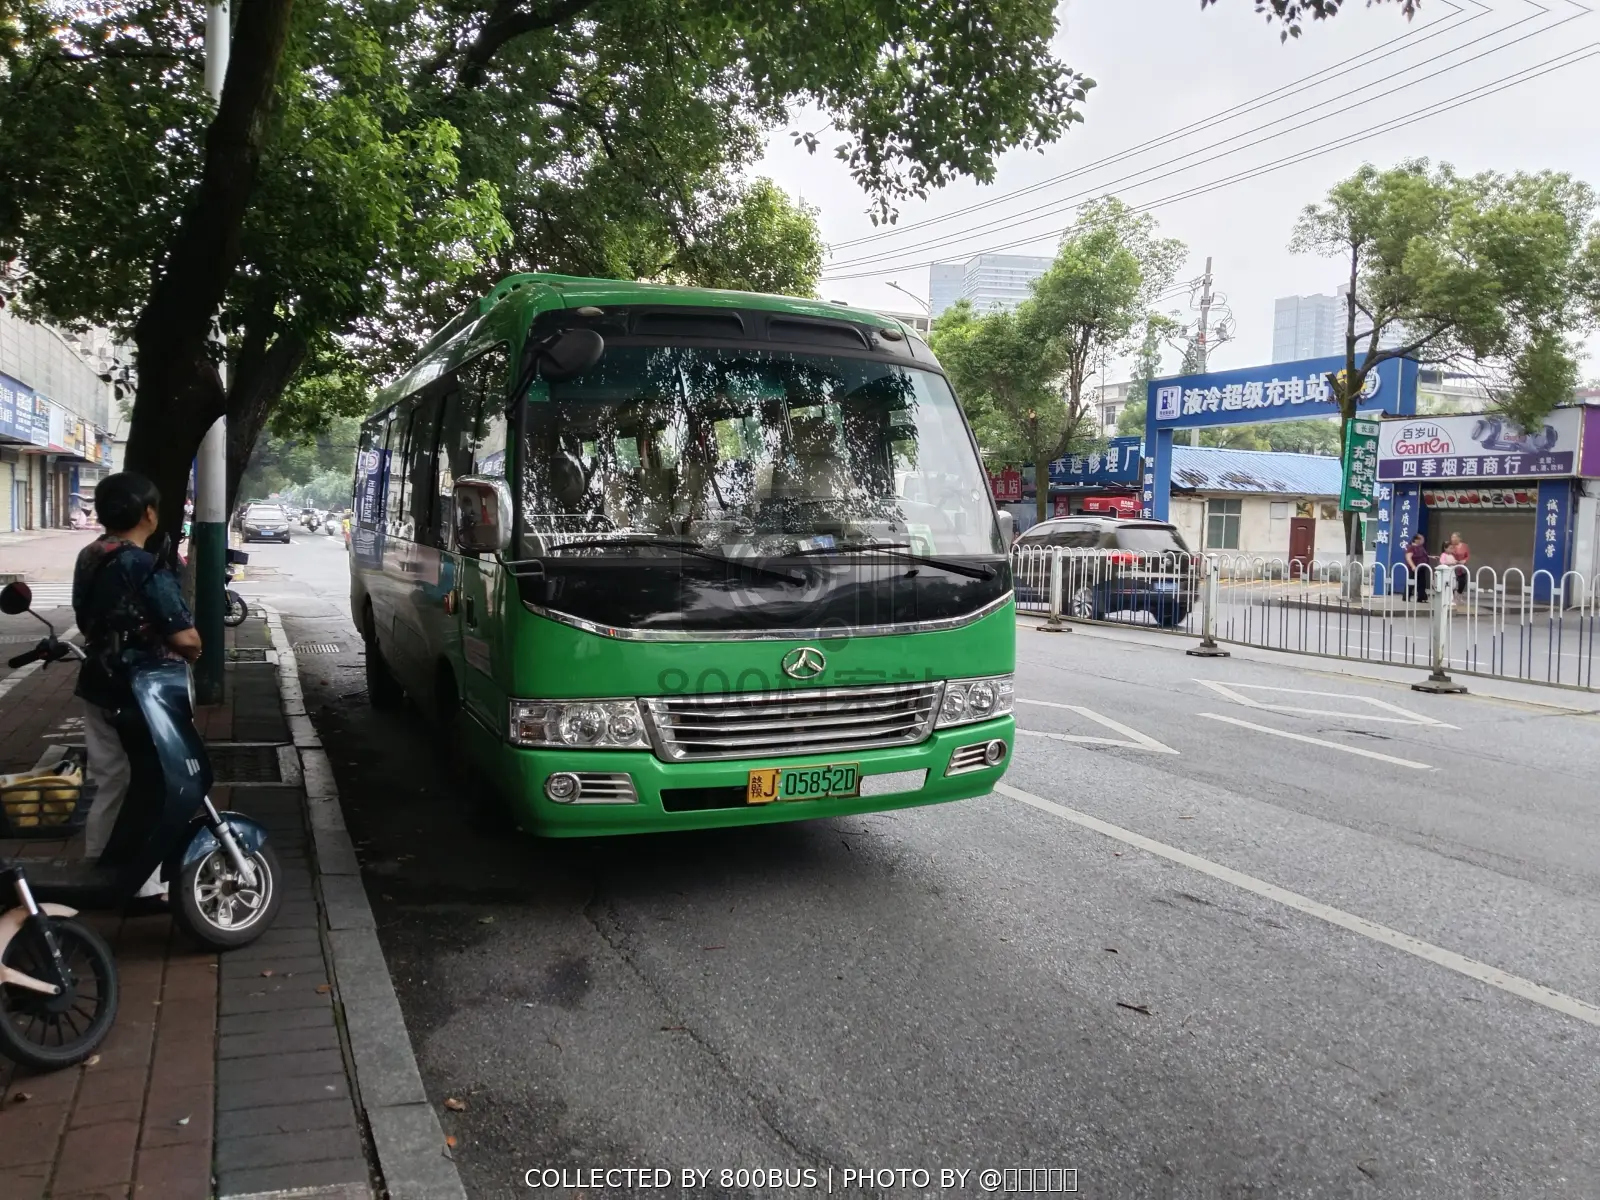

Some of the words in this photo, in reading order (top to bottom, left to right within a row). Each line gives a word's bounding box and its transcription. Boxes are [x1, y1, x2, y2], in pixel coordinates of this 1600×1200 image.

[1182, 371, 1333, 415] 液冷超级充电站
[1403, 427, 1439, 439] 百岁山
[989, 479, 1019, 494] 商店
[1351, 446, 1365, 489] 充电站
[1361, 439, 1377, 497] 电动汽车
[1402, 456, 1522, 477] 四季烟酒商行
[1376, 486, 1390, 544] 充电站
